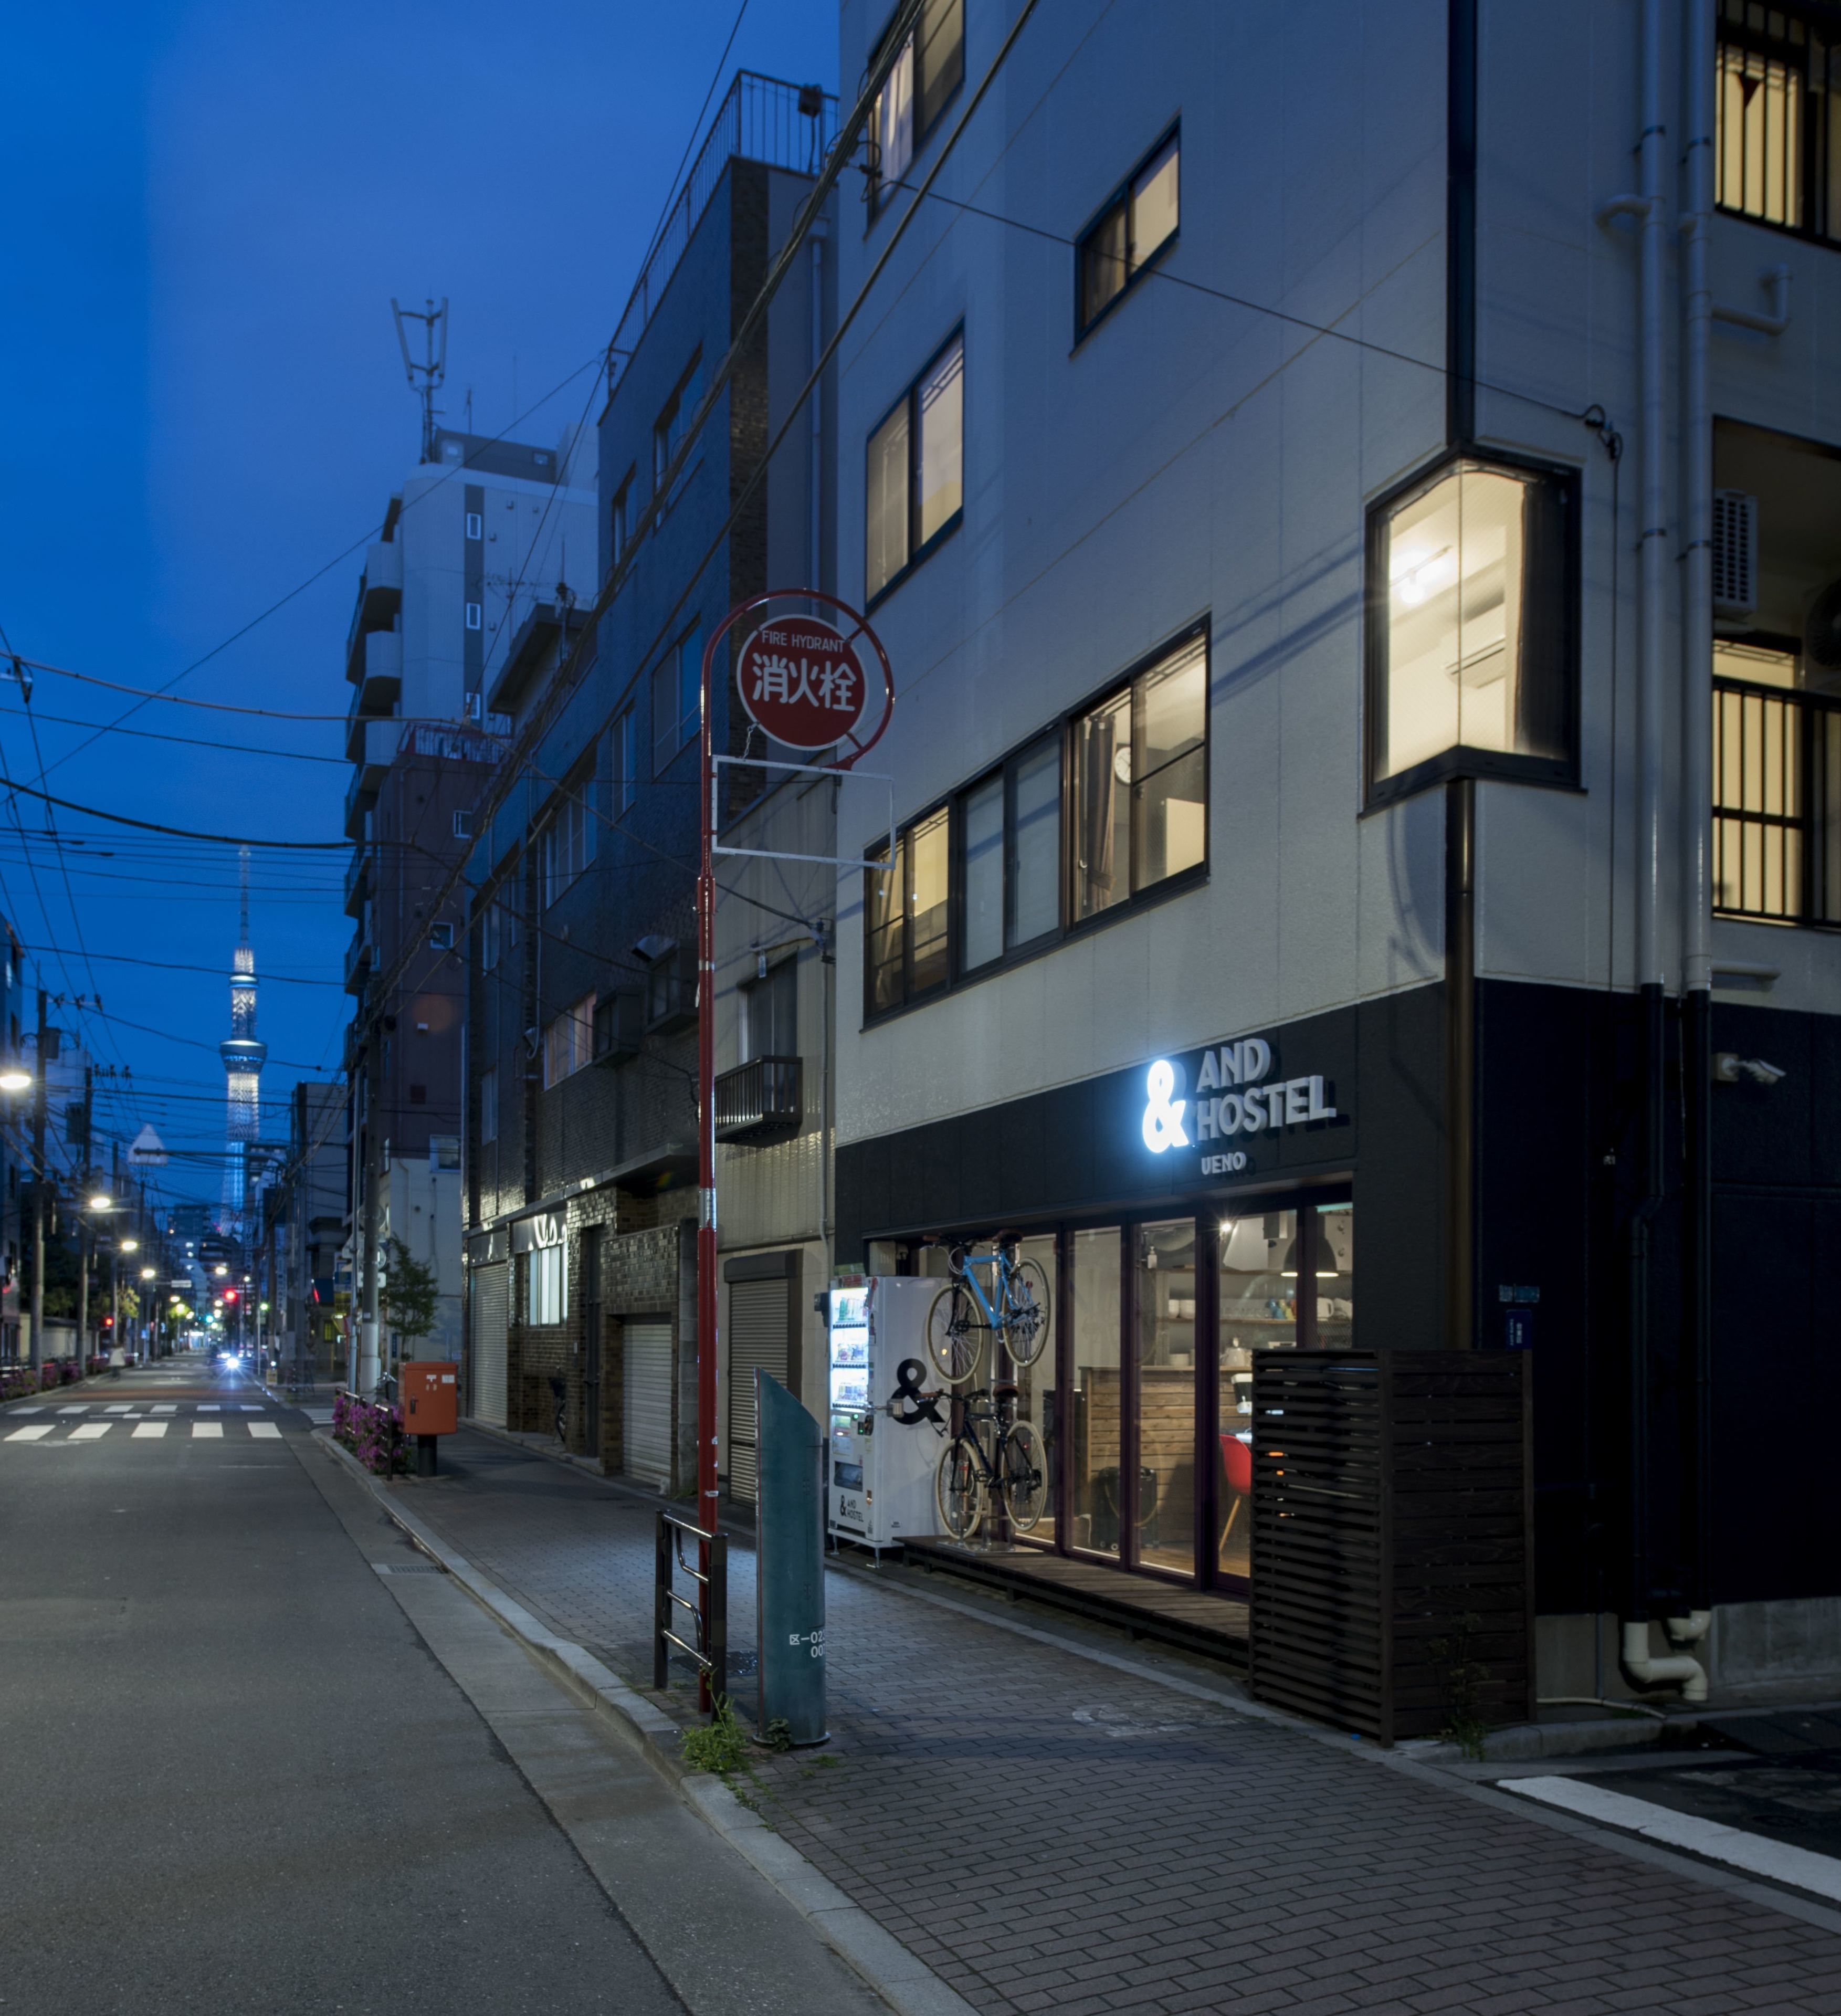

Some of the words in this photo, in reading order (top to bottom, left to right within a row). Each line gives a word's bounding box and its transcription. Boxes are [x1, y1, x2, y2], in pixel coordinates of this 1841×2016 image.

[762, 630, 787, 646] FIRE
[792, 634, 845, 654] HYDRANT
[752, 652, 857, 712] 消火栓
[1196, 1038, 1271, 1093] AND
[1142, 1059, 1189, 1153] &
[1197, 1075, 1337, 1141] HOSTEL
[1201, 1151, 1247, 1175] UENO
[891, 1358, 945, 1425] &
[790, 1630, 825, 1645] 区-02
[811, 1644, 825, 1658] 00
